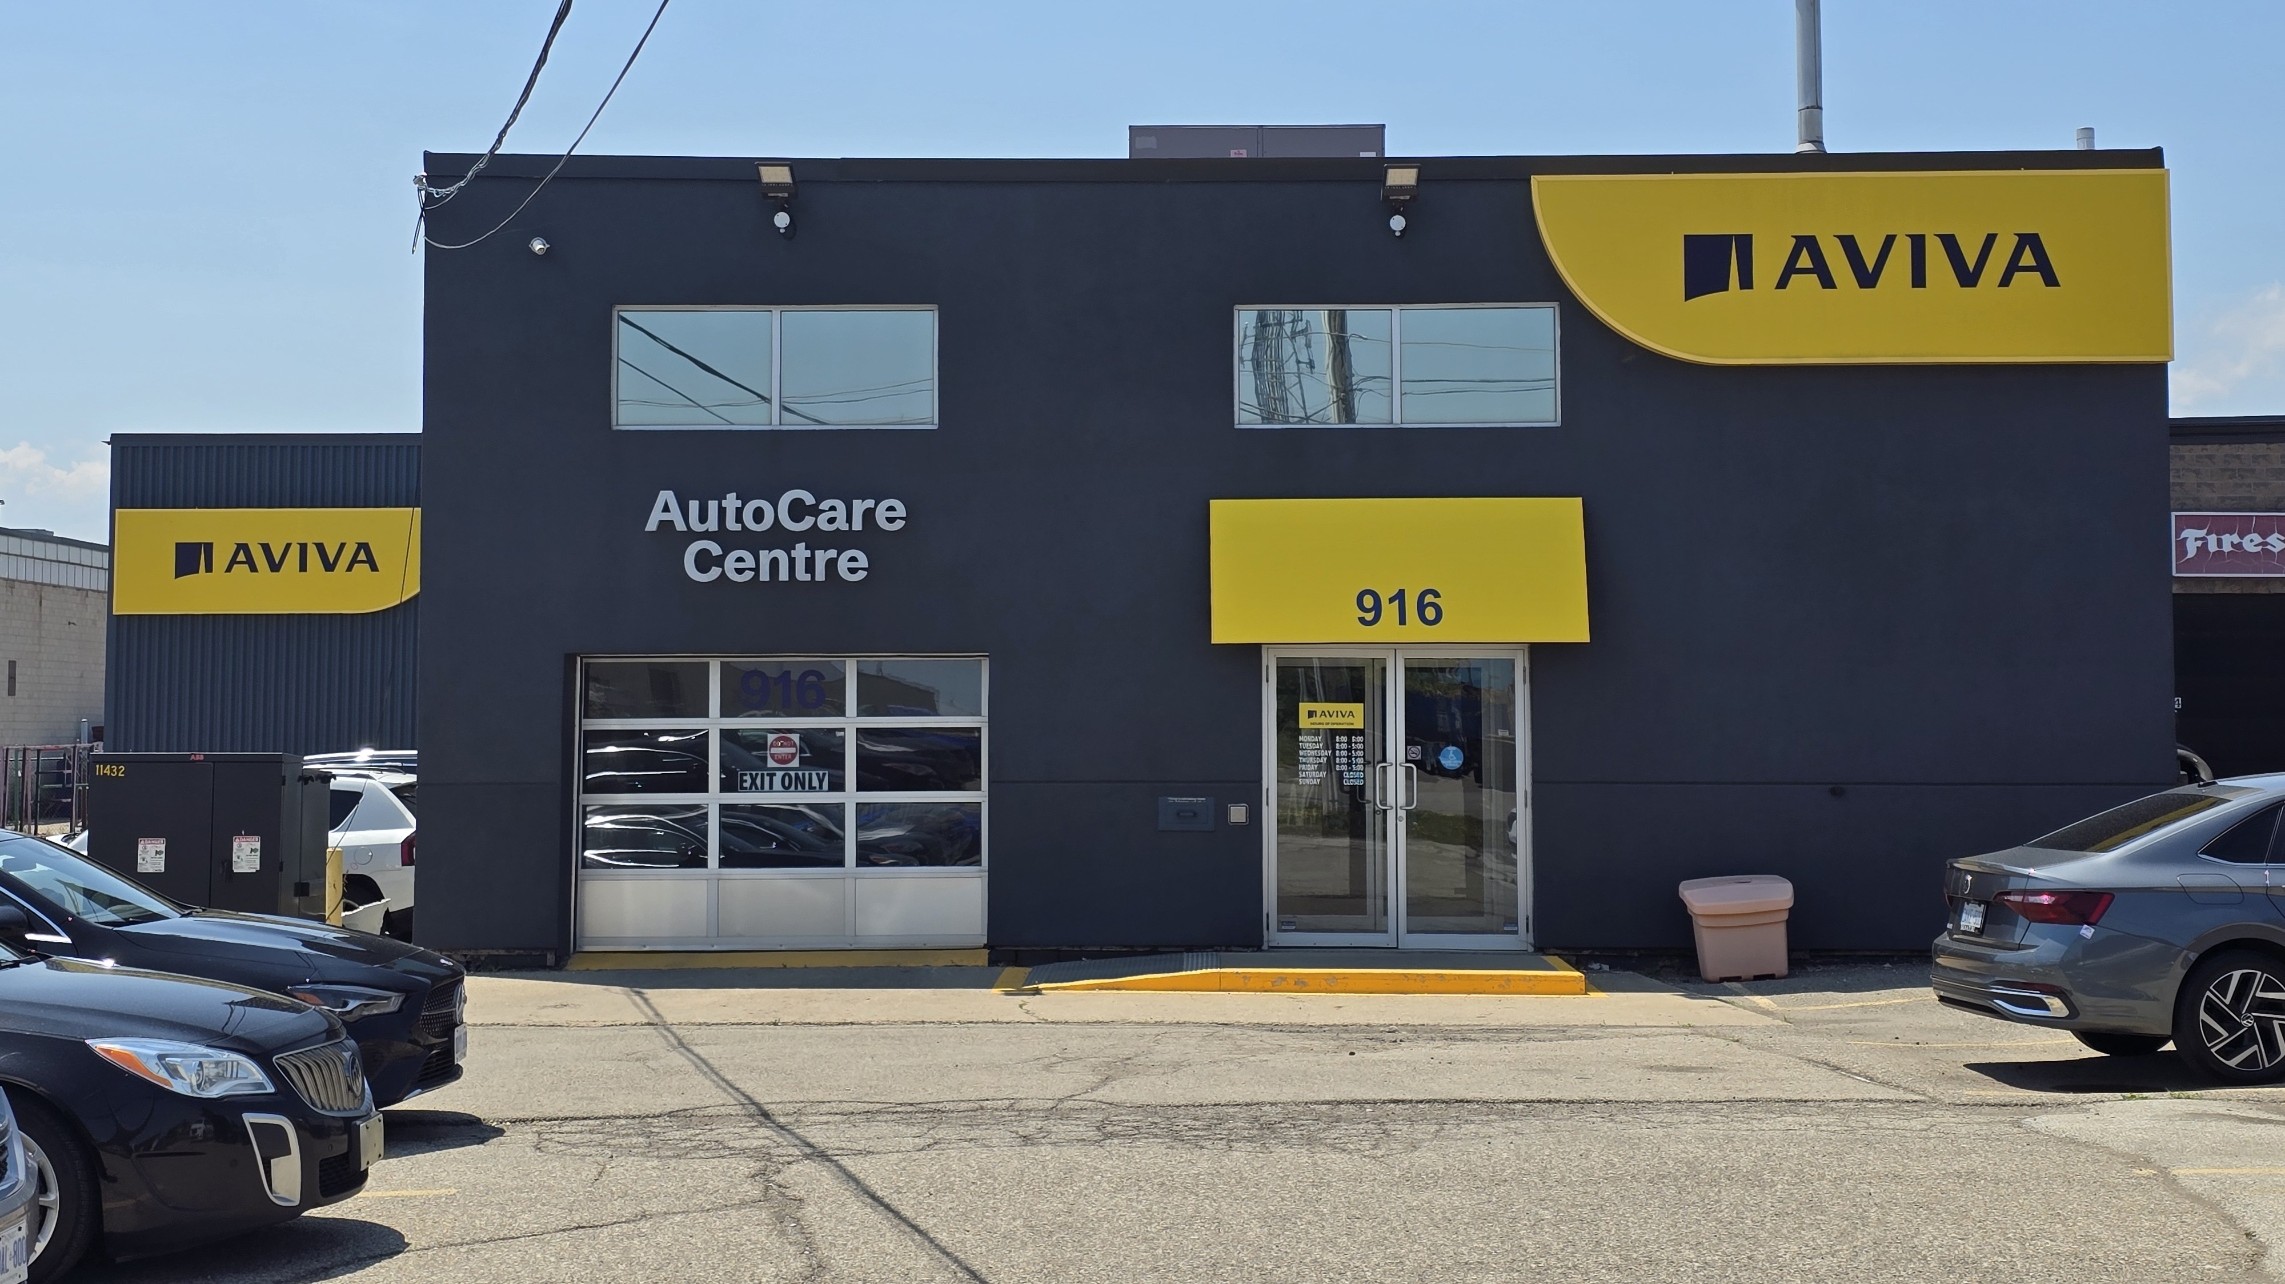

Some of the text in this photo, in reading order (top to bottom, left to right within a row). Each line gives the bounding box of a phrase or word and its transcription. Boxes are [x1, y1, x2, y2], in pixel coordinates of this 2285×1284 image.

[1774, 233, 2061, 289] AVIVA
[644, 489, 907, 532] AutoCare
[224, 542, 380, 573] AVIVA
[683, 540, 869, 583] Centre
[1356, 588, 1443, 626] 916
[741, 669, 826, 710] 916
[1319, 710, 1355, 718] AVIVA
[96, 764, 125, 777] 11432
[739, 772, 827, 790] EXIT ONLY
